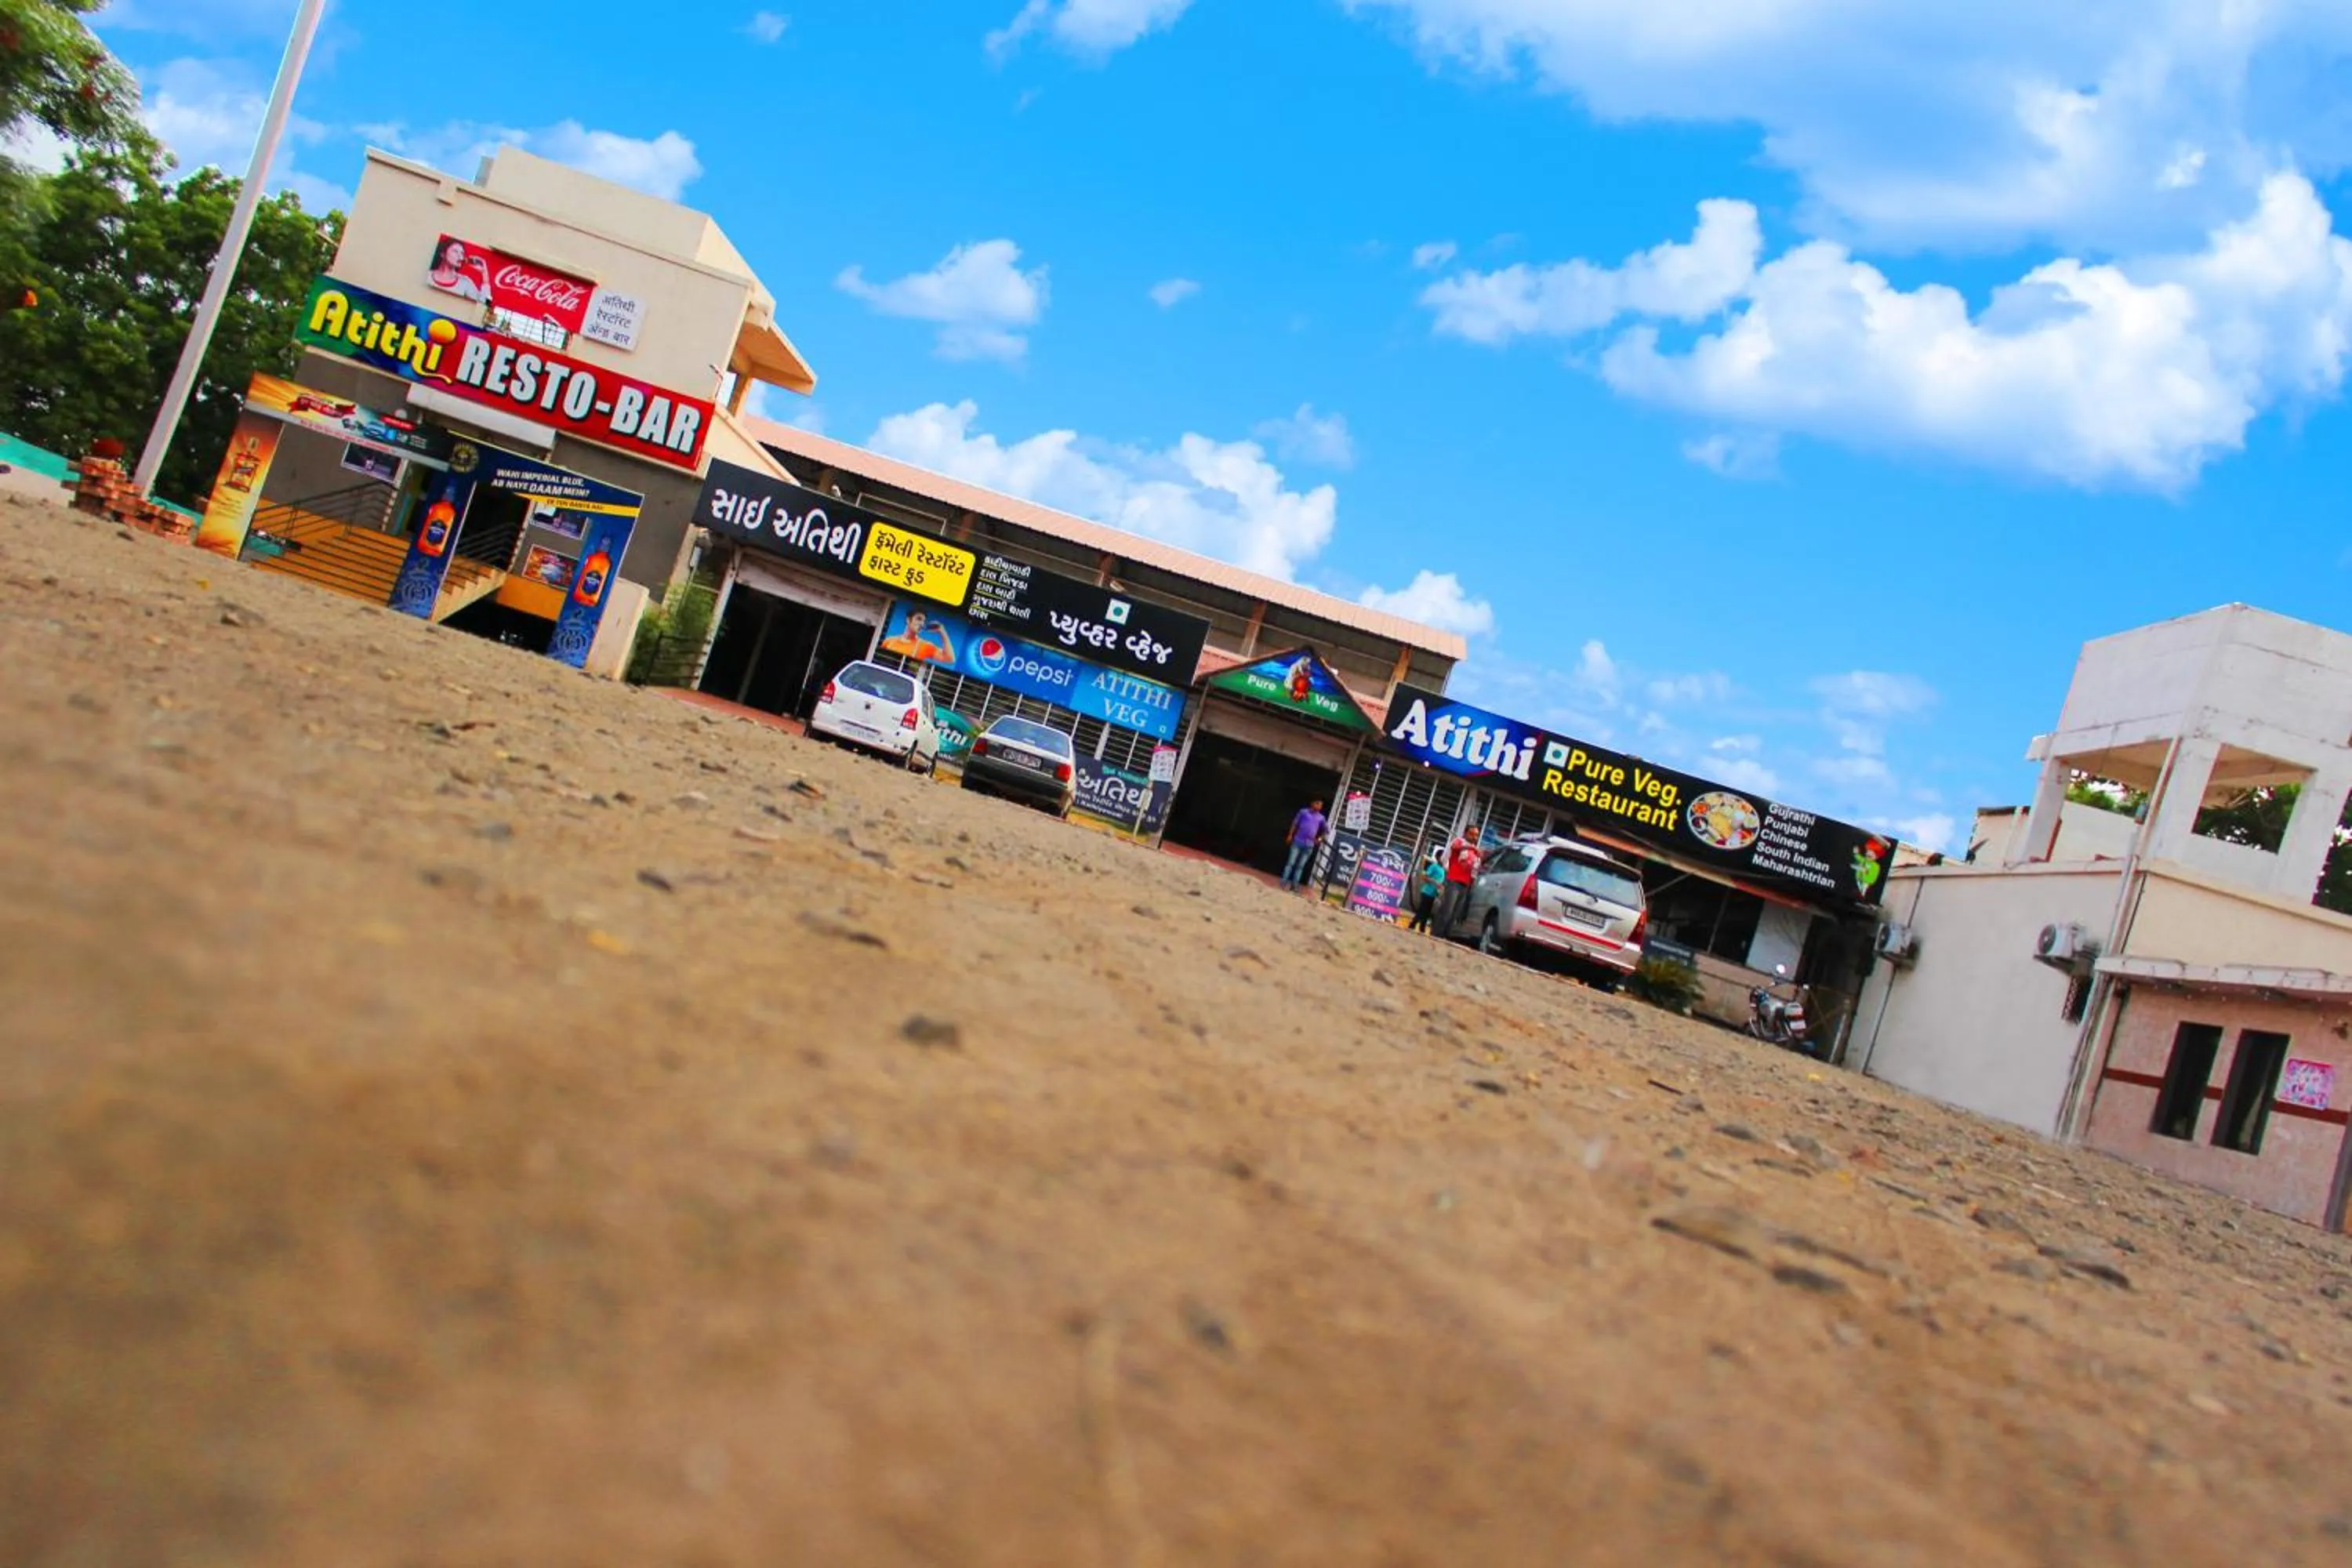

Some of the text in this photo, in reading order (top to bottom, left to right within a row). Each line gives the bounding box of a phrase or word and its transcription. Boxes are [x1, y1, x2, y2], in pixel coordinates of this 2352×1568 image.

[495, 264, 586, 311] Coca-Cola
[309, 290, 702, 454] Atithi RESTO-BAR
[506, 481, 528, 491] NAYE
[528, 482, 563, 495] DAAM
[521, 470, 560, 484] IMPERIAL
[772, 509, 862, 564] અતિથી
[1008, 656, 1072, 687] pepsi
[1091, 672, 1173, 710] ATITHI
[1247, 675, 1338, 713] Pure Veg
[1103, 698, 1149, 728] VEG
[1391, 699, 1538, 781] Atithi
[1567, 749, 1683, 808] Pure Veg.
[1542, 768, 1679, 831] Restaurant
[1768, 804, 1816, 826] Gujrathi
[1760, 829, 1807, 851] Chinese
[1765, 816, 1809, 838] Punjabi
[1751, 854, 1836, 888] Maharashtrian
[1755, 841, 1830, 873] South Indian
